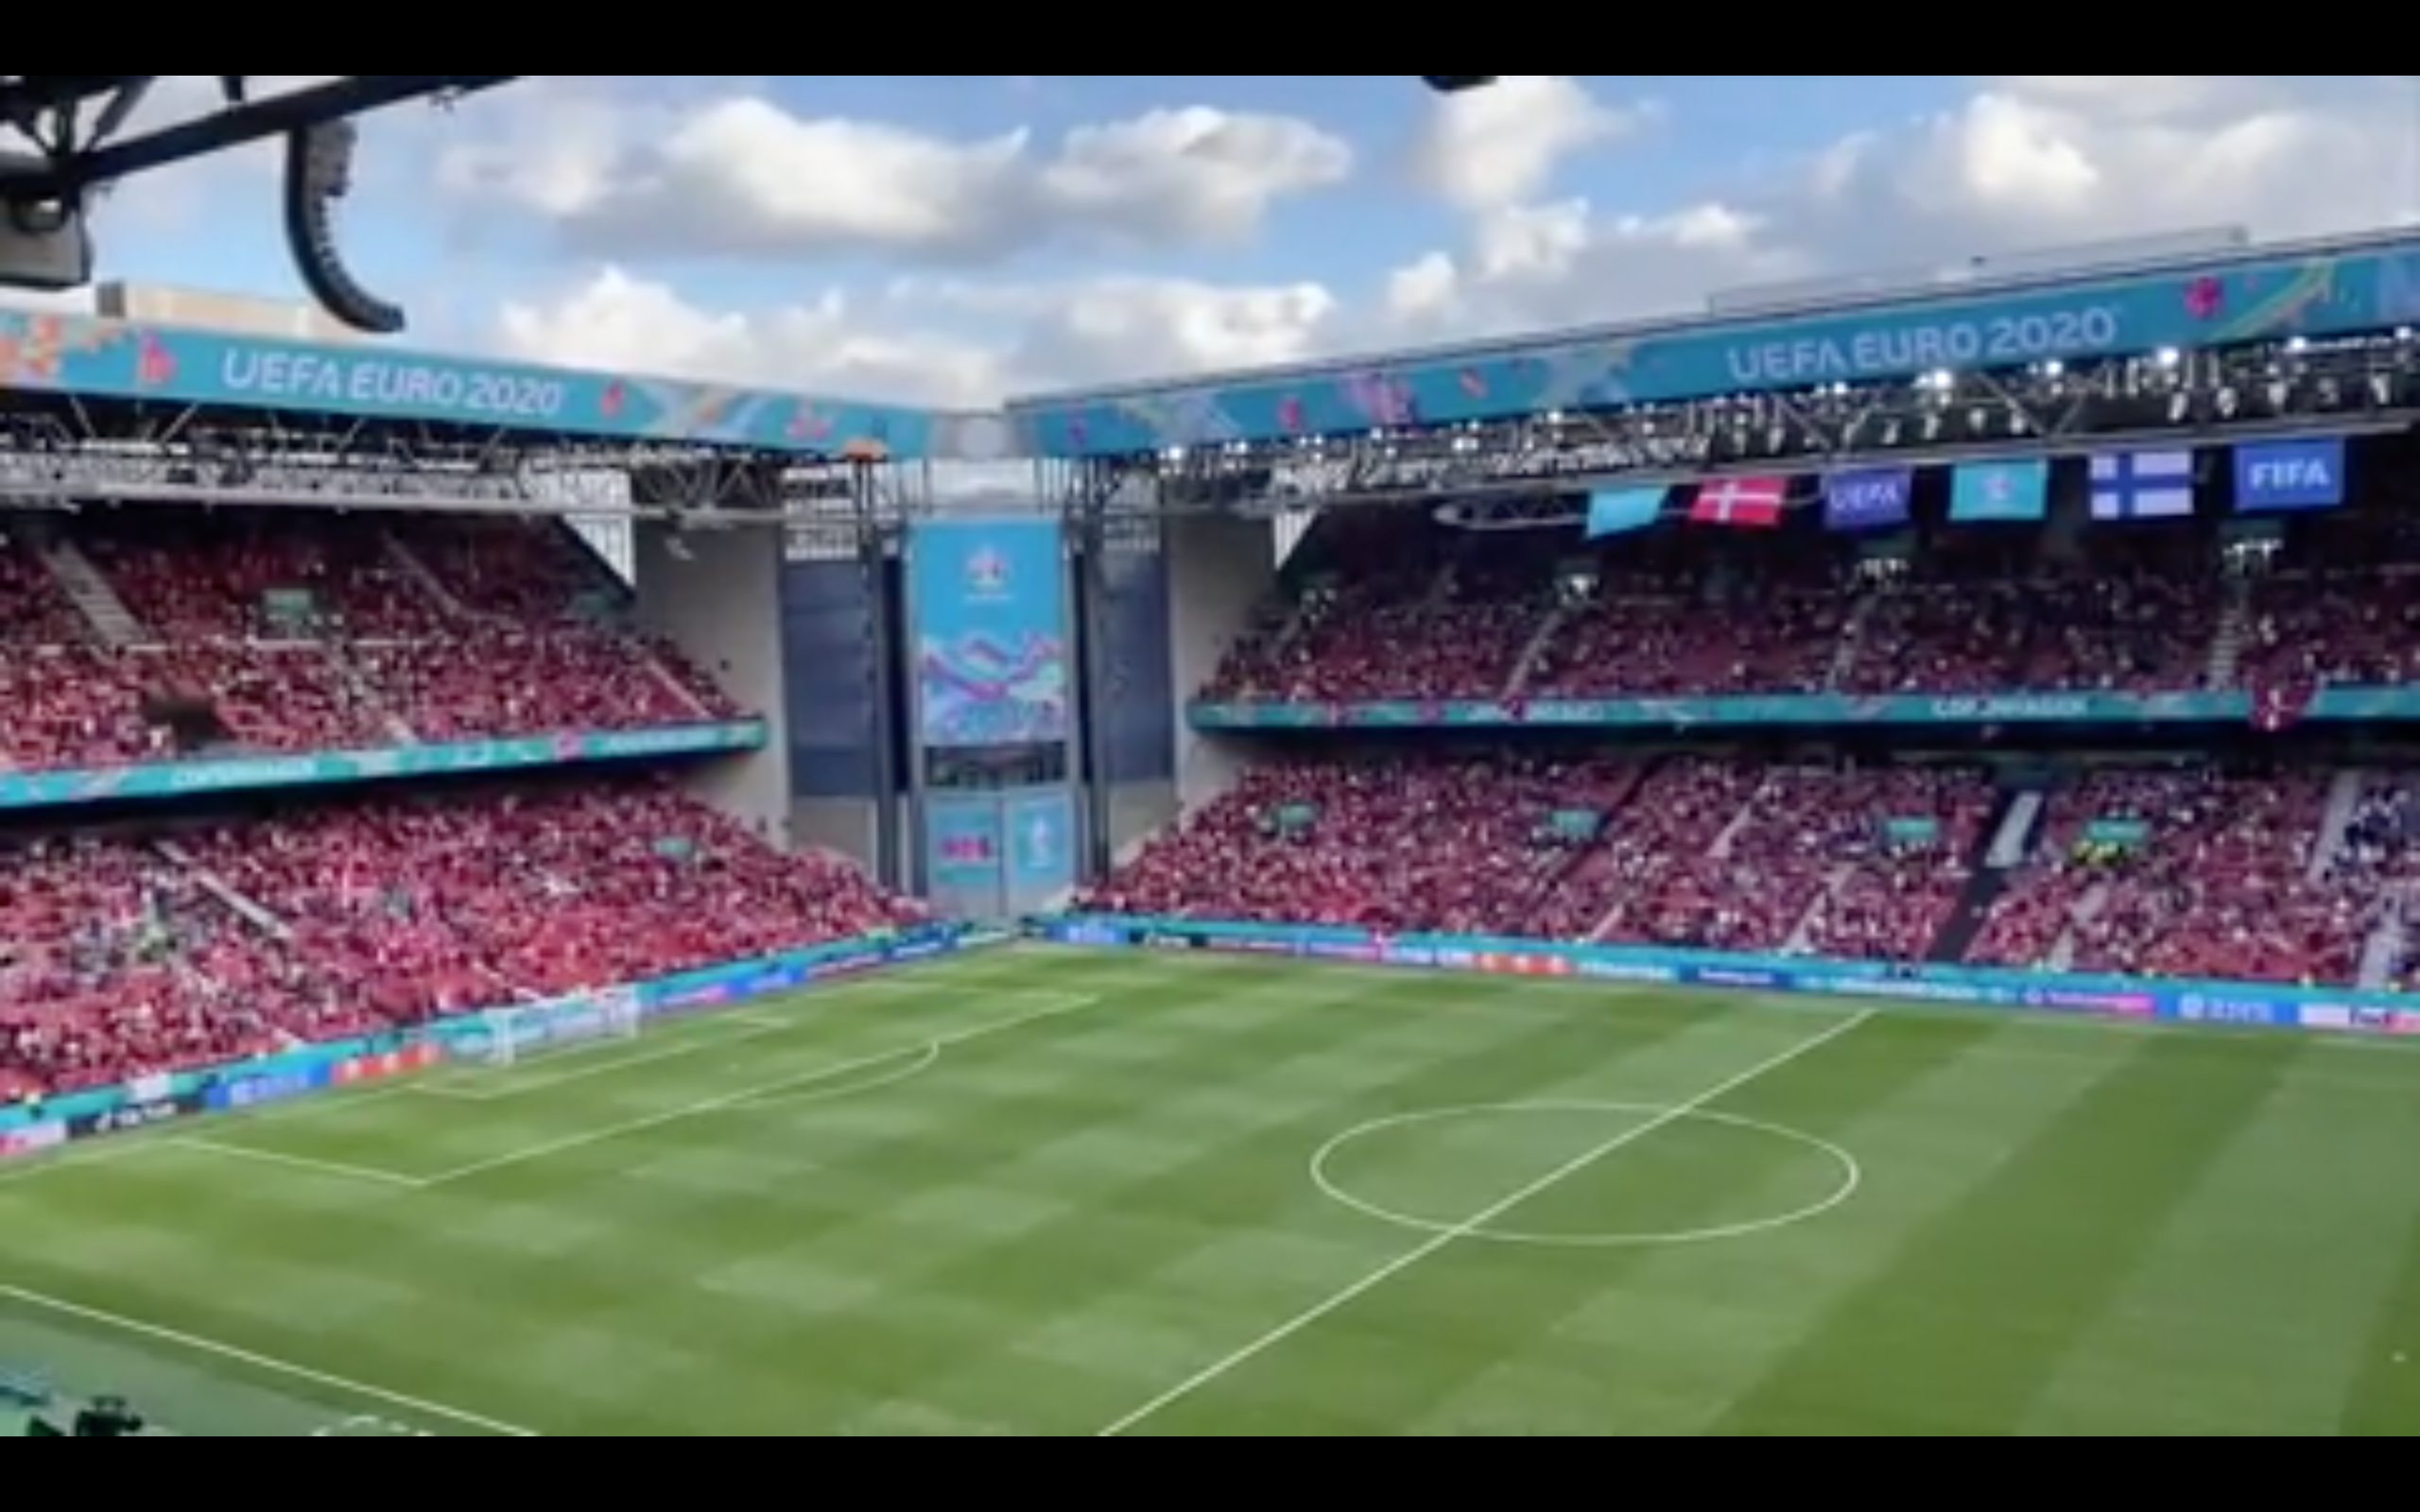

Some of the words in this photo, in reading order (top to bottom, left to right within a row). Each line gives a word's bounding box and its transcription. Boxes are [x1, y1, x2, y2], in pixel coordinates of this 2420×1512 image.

[1728, 337, 1848, 380] UEFA
[1854, 321, 1979, 369] EURO
[1990, 305, 2117, 357] 2020
[221, 348, 340, 397] UEFA
[347, 362, 461, 406] EURO
[461, 373, 562, 416] 2020
[1828, 482, 1897, 510] UEFA
[2250, 457, 2331, 490] FIFA
